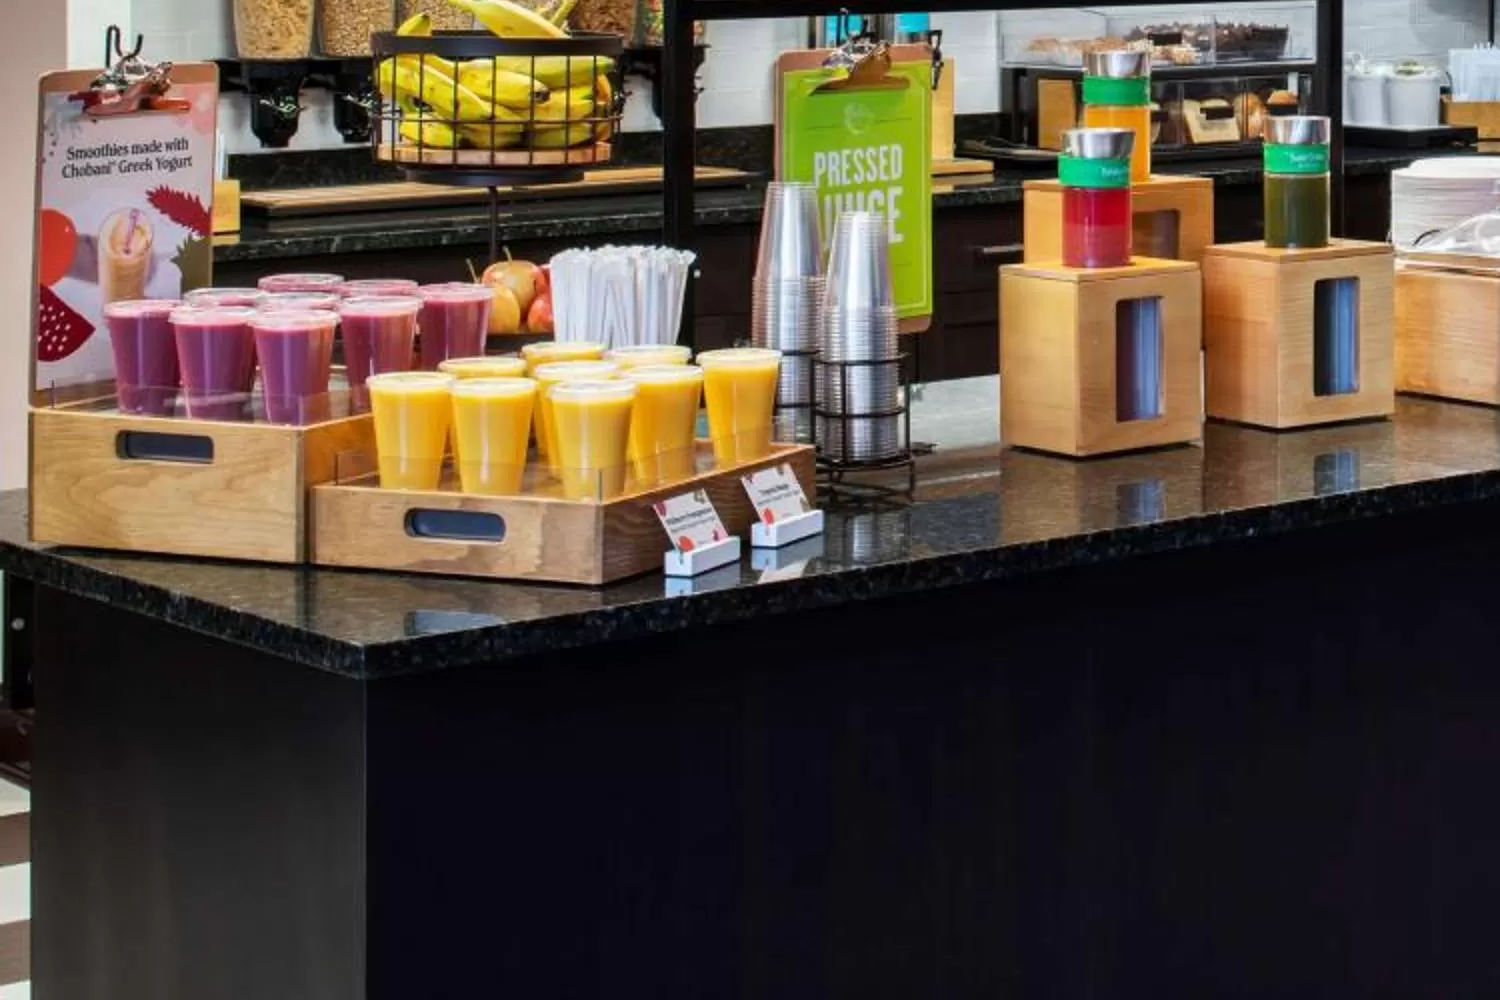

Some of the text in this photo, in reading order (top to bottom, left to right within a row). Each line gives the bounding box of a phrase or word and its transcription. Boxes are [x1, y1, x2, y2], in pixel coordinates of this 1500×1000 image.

[67, 137, 189, 160] Smoothies made with
[117, 158, 154, 174] Greek
[155, 155, 192, 172] Yogurt
[813, 143, 904, 187] PRESSED
